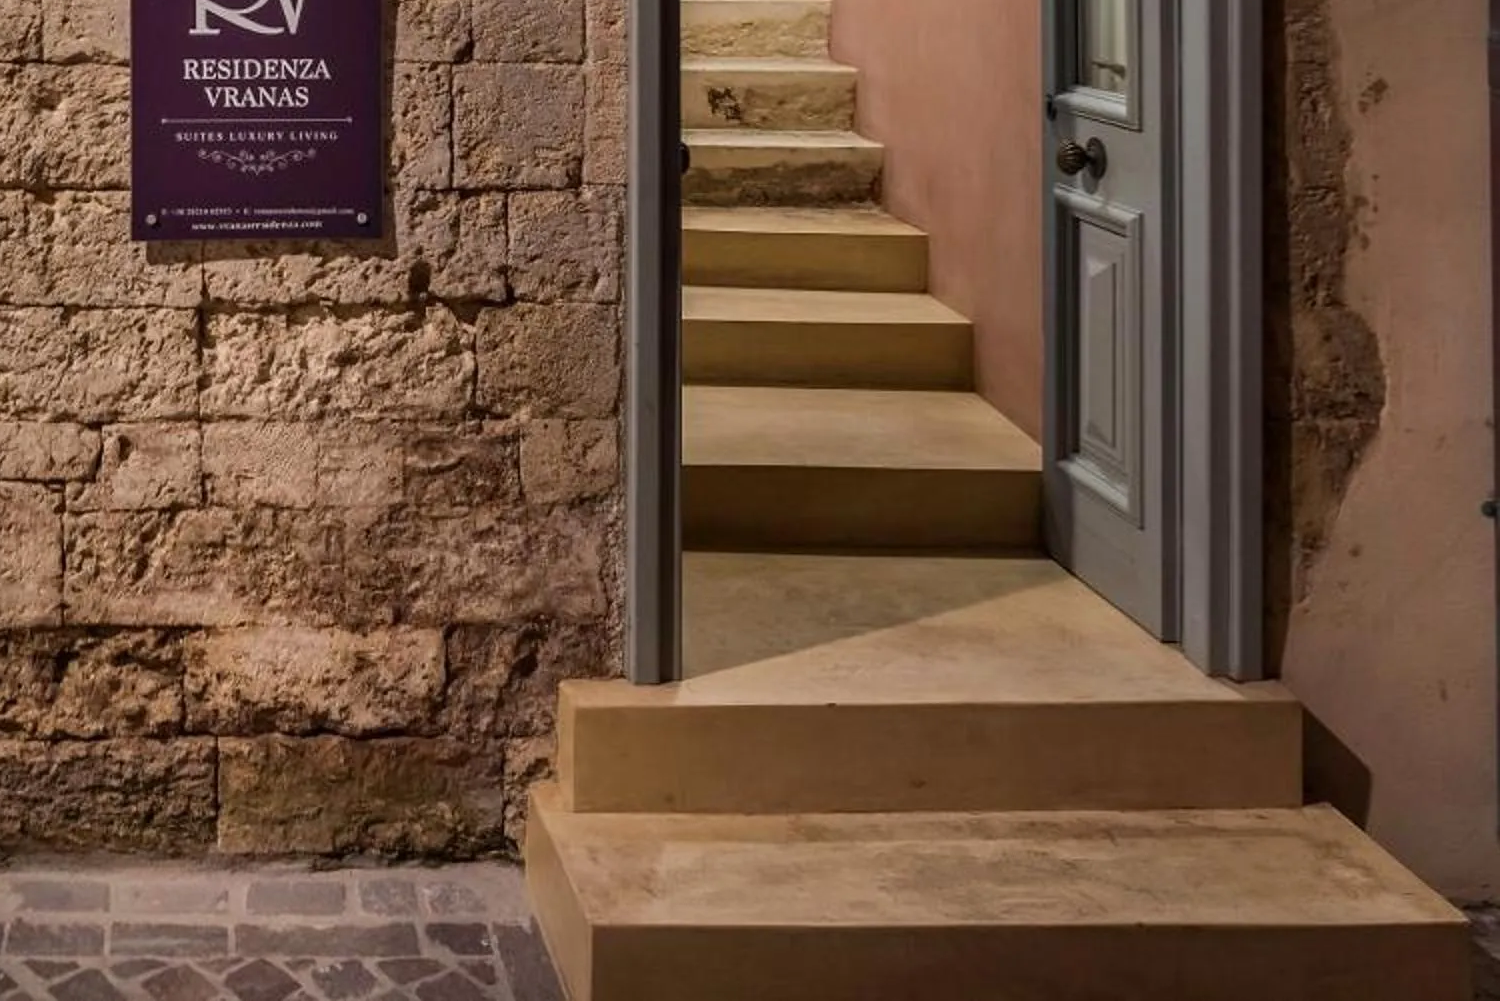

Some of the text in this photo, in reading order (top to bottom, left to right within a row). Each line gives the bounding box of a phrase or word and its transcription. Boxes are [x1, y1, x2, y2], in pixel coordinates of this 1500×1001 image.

[183, 58, 331, 81] RESIDENZA
[204, 86, 309, 108] VRANAS
[175, 130, 339, 143] SUITES LUXURY LIVING
